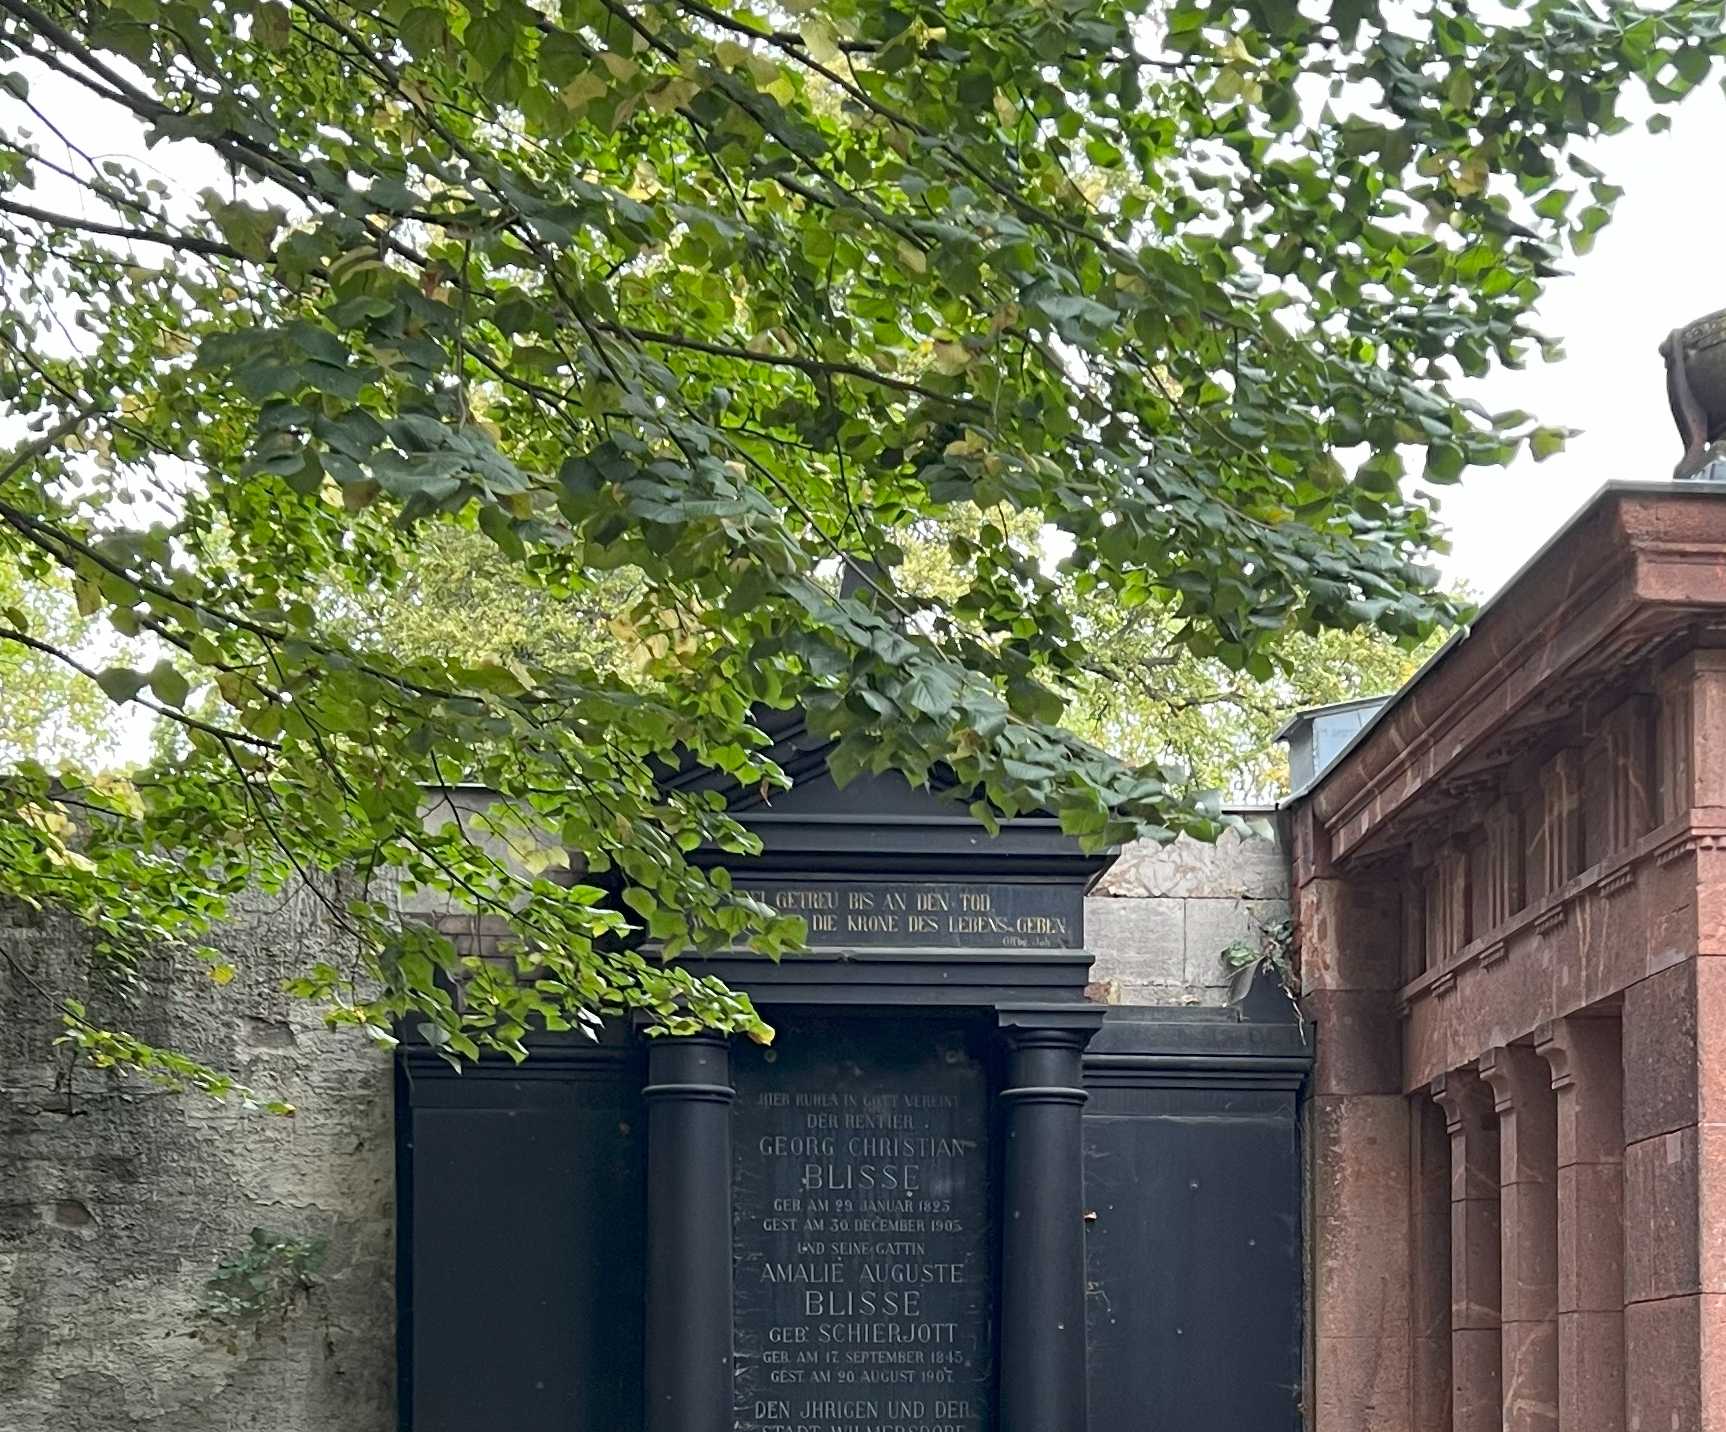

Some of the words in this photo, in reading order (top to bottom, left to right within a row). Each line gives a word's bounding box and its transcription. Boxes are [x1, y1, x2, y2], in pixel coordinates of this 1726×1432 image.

[776, 891, 839, 909] GETREU
[849, 892, 875, 910] BIS
[884, 892, 906, 911] AN
[917, 893, 950, 911] DEN
[812, 914, 838, 931] DIE
[847, 915, 898, 932] KRONE
[908, 916, 939, 932] DES
[807, 1114, 838, 1129] DER
[845, 1114, 913, 1129] RENTIER
[759, 1136, 835, 1157] GEORG
[848, 1136, 966, 1158] CHRISTIAN
[805, 1164, 920, 1190] BLISSE
[808, 1199, 830, 1213] AM
[860, 1199, 913, 1213] JANUAR
[804, 1218, 825, 1232] AM
[854, 1218, 926, 1233] DECEMBER
[798, 1242, 825, 1256] UND
[832, 1242, 869, 1256] SEINE
[875, 1242, 926, 1256] GATTIN
[760, 1262, 845, 1283] AMALIE
[859, 1263, 966, 1283] AUGUSTE
[805, 1290, 921, 1316] BLISSE
[818, 1323, 959, 1343] SCHIERJOTT
[796, 1351, 819, 1364] AM
[845, 1350, 925, 1364] SEPTEMBER
[931, 1350, 963, 1364] 1845
[810, 1369, 831, 1384] AM
[862, 1369, 916, 1384] AUGUST
[755, 1400, 791, 1419] DEN
[800, 1400, 878, 1419] JHRIGEN
[888, 1401, 925, 1418] UND
[935, 1401, 970, 1418] DER
